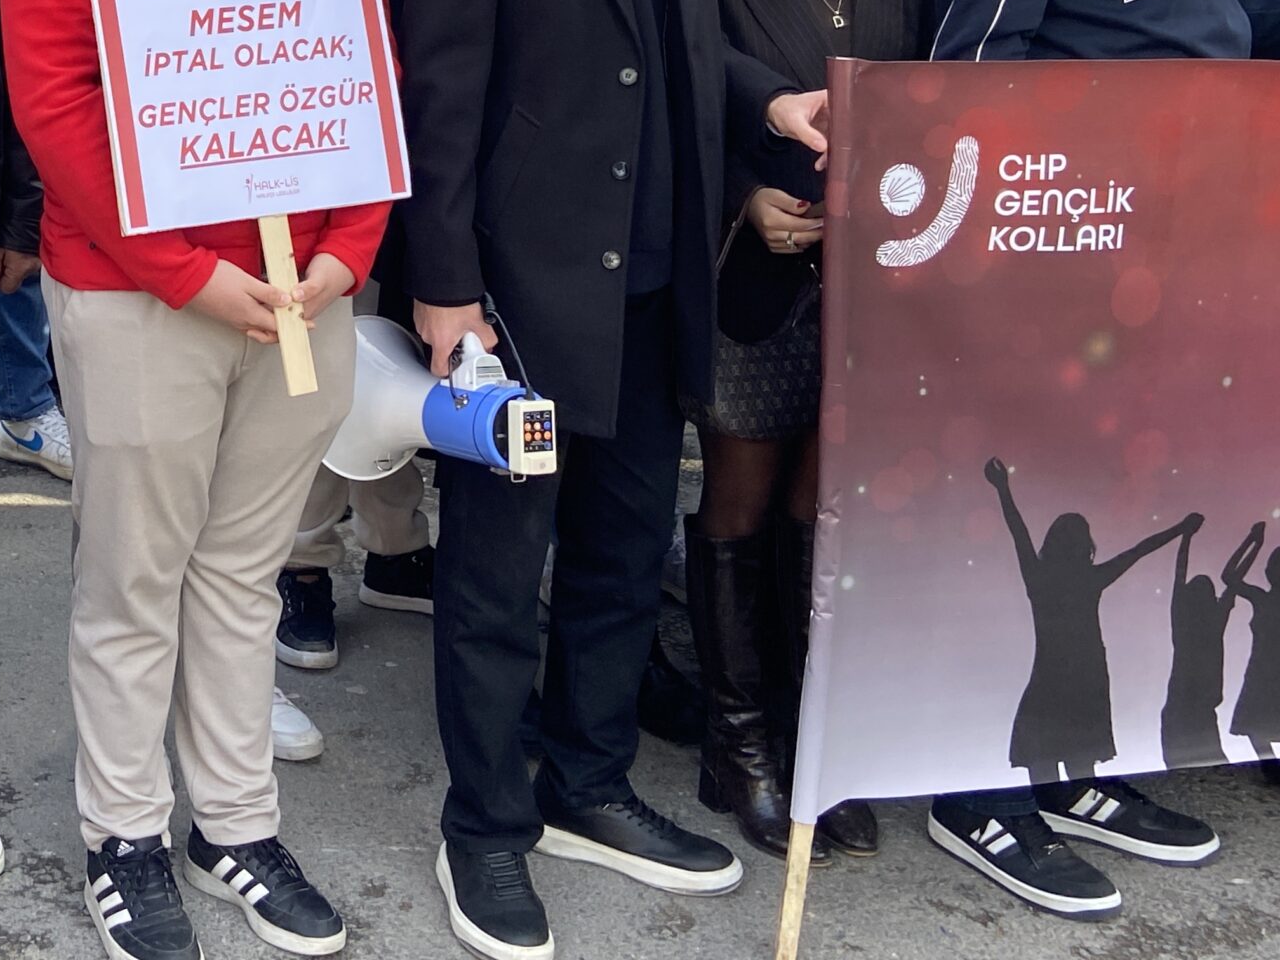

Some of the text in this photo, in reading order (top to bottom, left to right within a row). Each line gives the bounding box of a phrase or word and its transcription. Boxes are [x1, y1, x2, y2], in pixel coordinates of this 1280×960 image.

[189, 0, 301, 37] MESEM
[145, 34, 353, 77] İPTAL OLACAK;
[138, 78, 373, 128] GENÇLER ÖZGÜR
[180, 119, 347, 165] KALACAK!
[998, 154, 1067, 181] CHP
[994, 180, 1135, 223] GENÇLİK
[988, 224, 1124, 252] KOLLARI
